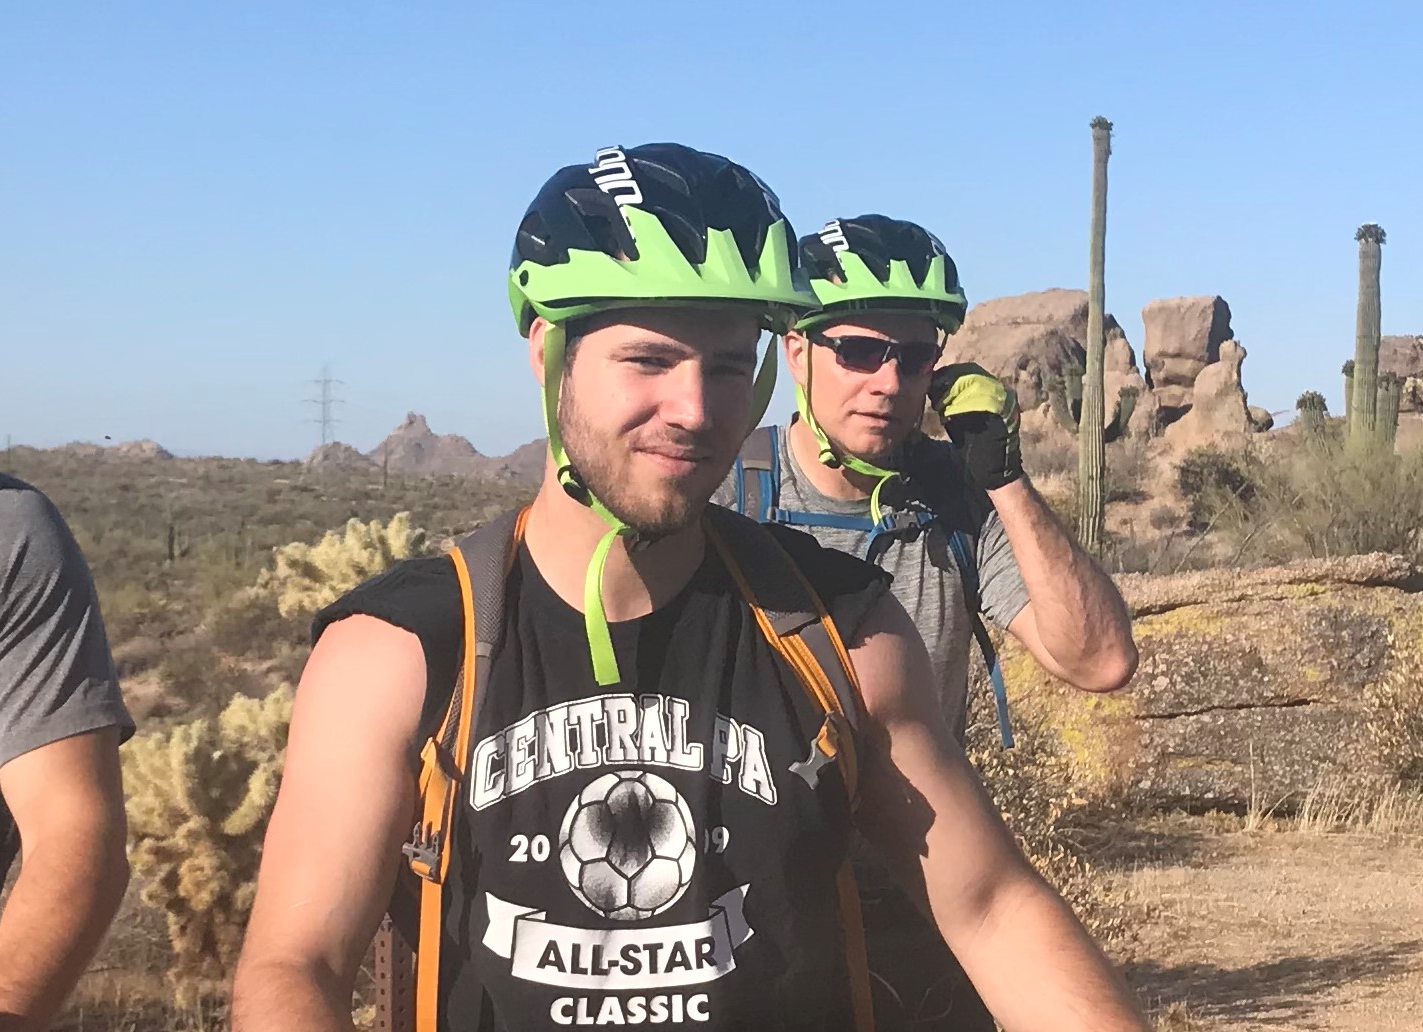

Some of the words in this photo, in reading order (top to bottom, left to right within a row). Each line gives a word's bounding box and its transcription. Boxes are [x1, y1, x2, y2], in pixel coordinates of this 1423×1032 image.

[469, 693, 704, 811] CENTRAL
[709, 712, 778, 805] PA
[508, 834, 550, 862] 20
[537, 937, 717, 976] ALL-STAR
[550, 993, 710, 1025] CLASSIC
